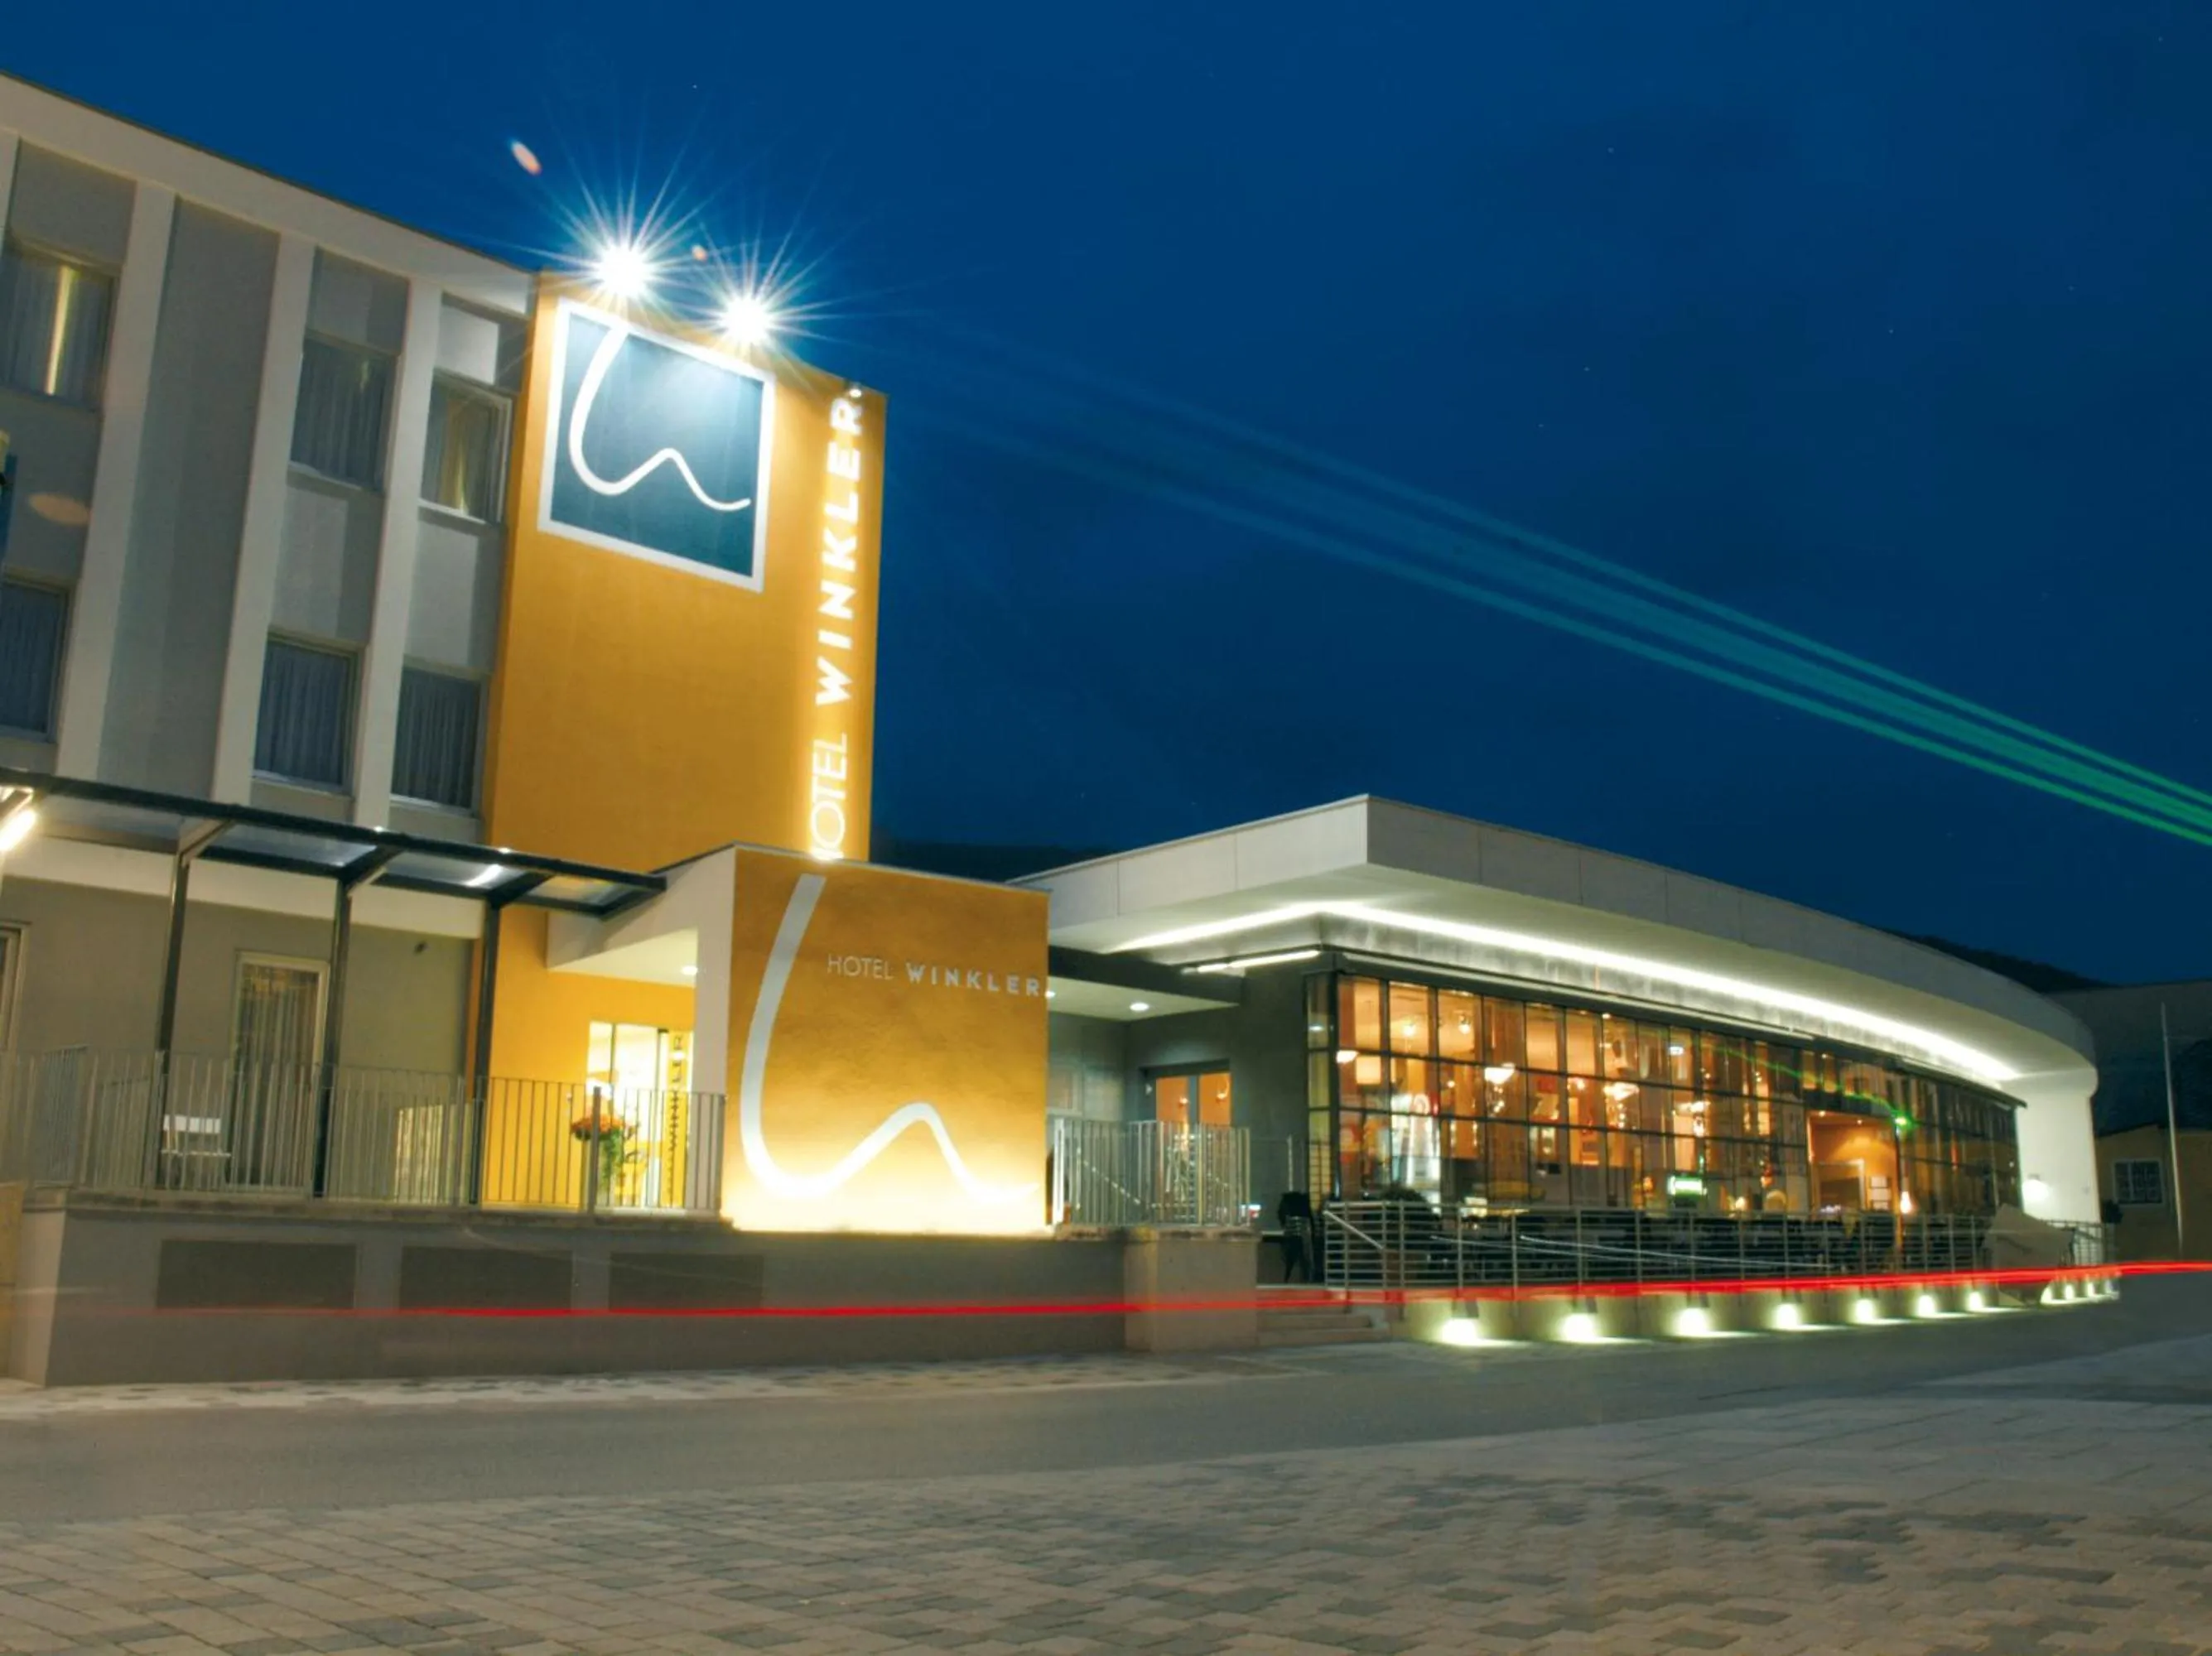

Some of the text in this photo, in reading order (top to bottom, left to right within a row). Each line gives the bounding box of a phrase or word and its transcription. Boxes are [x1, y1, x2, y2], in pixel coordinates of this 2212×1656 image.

[815, 397, 861, 706] WINKLER
[827, 954, 1040, 996] HOTEL WINKLER
